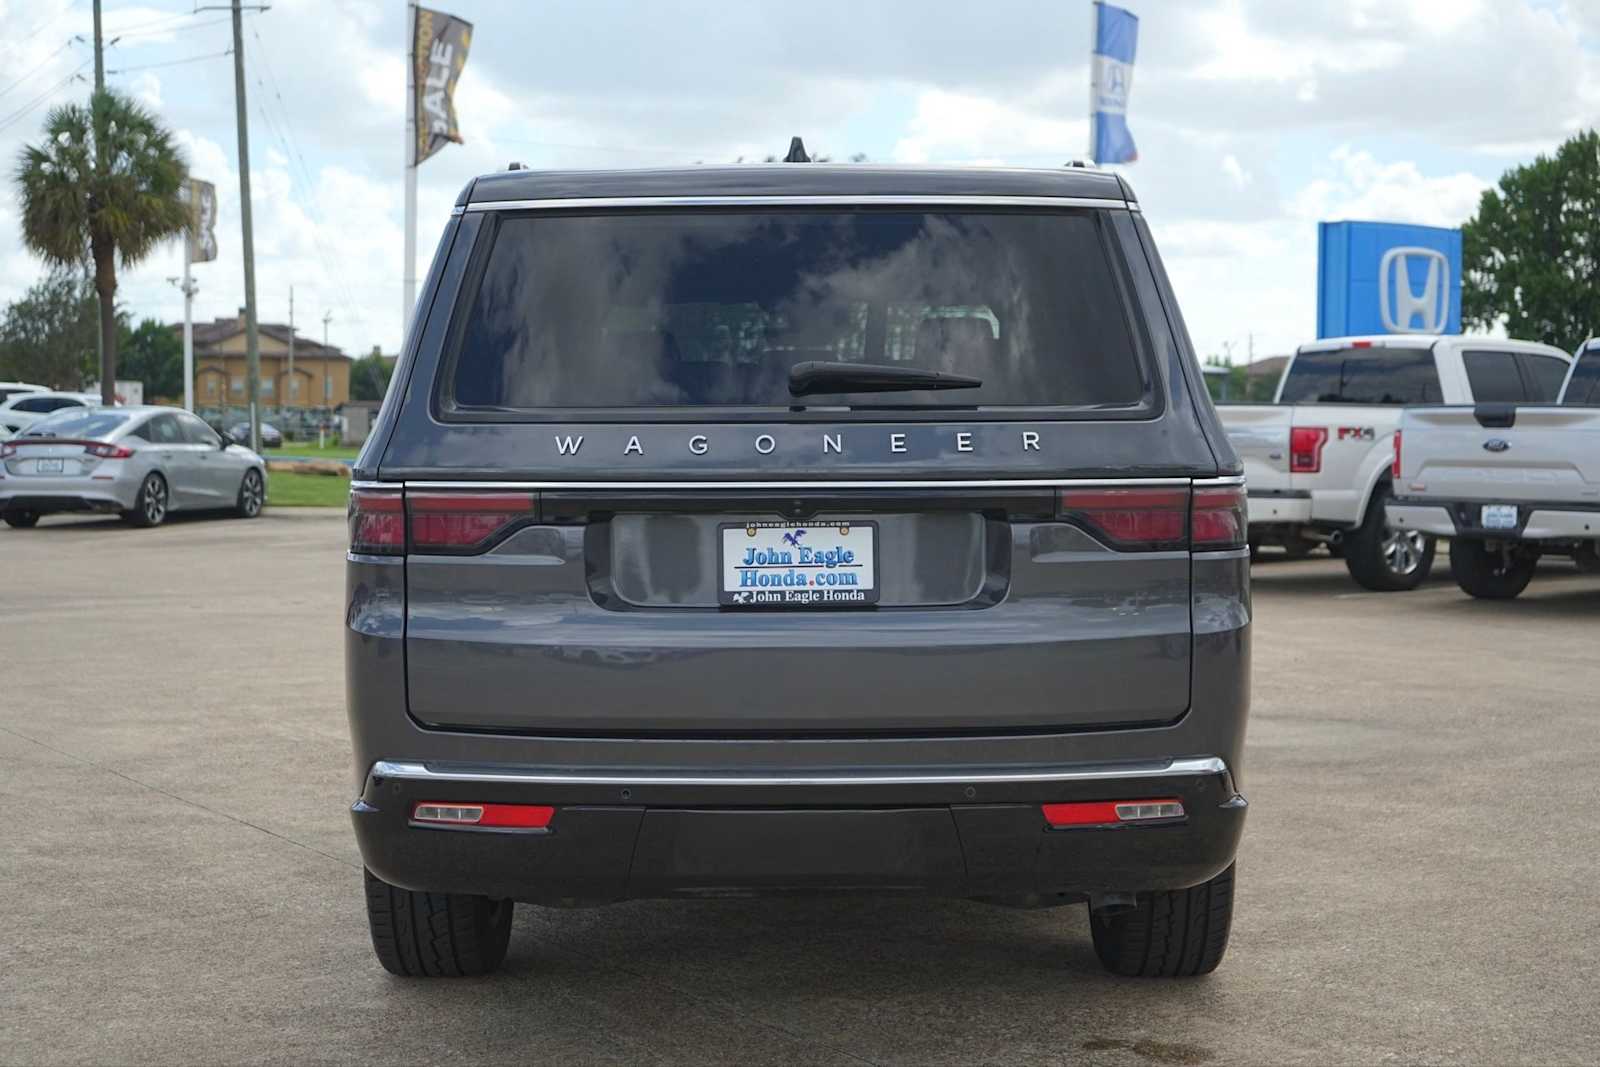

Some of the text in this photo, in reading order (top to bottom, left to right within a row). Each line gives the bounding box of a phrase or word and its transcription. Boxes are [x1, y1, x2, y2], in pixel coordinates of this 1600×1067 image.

[1338, 426, 1375, 440] FX4
[554, 432, 1040, 455] WAGONEER
[742, 546, 855, 568] John Eagle
[739, 569, 858, 587] Honda.com
[750, 589, 865, 604] John Eagle Honda
